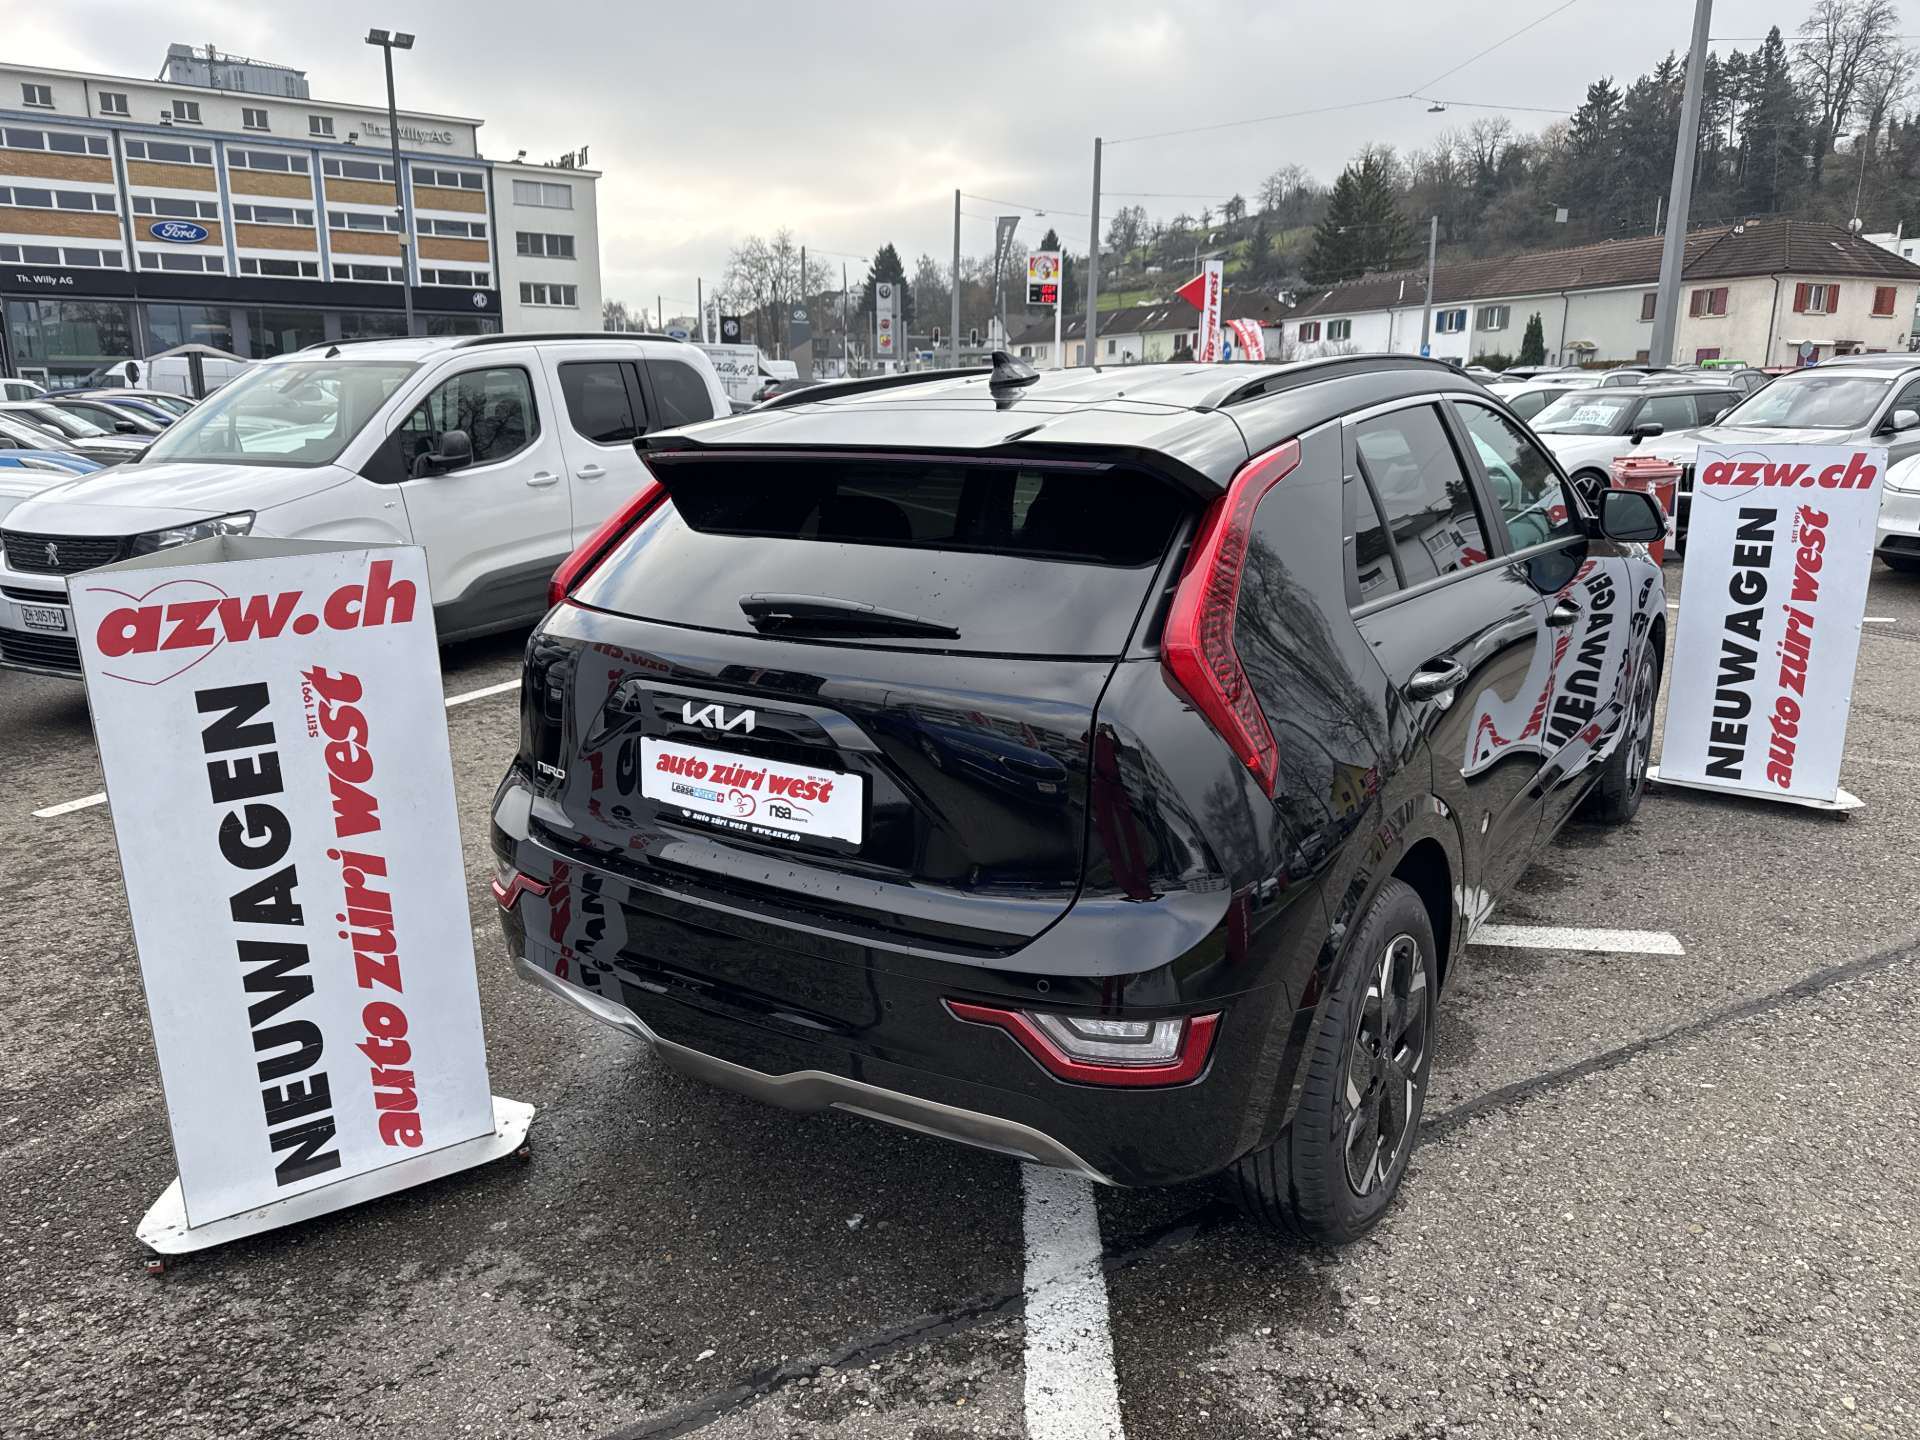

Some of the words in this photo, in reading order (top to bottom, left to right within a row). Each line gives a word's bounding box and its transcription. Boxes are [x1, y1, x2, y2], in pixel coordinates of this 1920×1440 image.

[430, 129, 455, 145] AG
[1733, 225, 1744, 235] 48
[15, 274, 31, 284] Th.
[33, 275, 57, 287] Willy
[59, 277, 74, 286] AG
[1703, 452, 1877, 489] azw.ch
[1790, 526, 1800, 544] SEIT
[1792, 504, 1830, 603] west
[96, 559, 417, 657] azw.ch
[1705, 507, 1778, 780] NEUWAGEN
[1778, 605, 1814, 695] züri
[300, 681, 315, 710] 1991
[305, 713, 319, 738] SEIT
[682, 700, 756, 733] KIA
[302, 664, 381, 838] west
[1766, 697, 1801, 789] auto
[537, 760, 567, 779] NIRO
[655, 753, 709, 780] auto
[708, 763, 767, 791] züri
[769, 774, 834, 804] west
[692, 811, 711, 823] auto
[710, 815, 728, 827] züri
[728, 819, 748, 831] west
[769, 803, 792, 821] nsa
[194, 681, 342, 1187] NEUWAGEN
[326, 848, 403, 993] züri
[358, 1001, 422, 1148] auto
